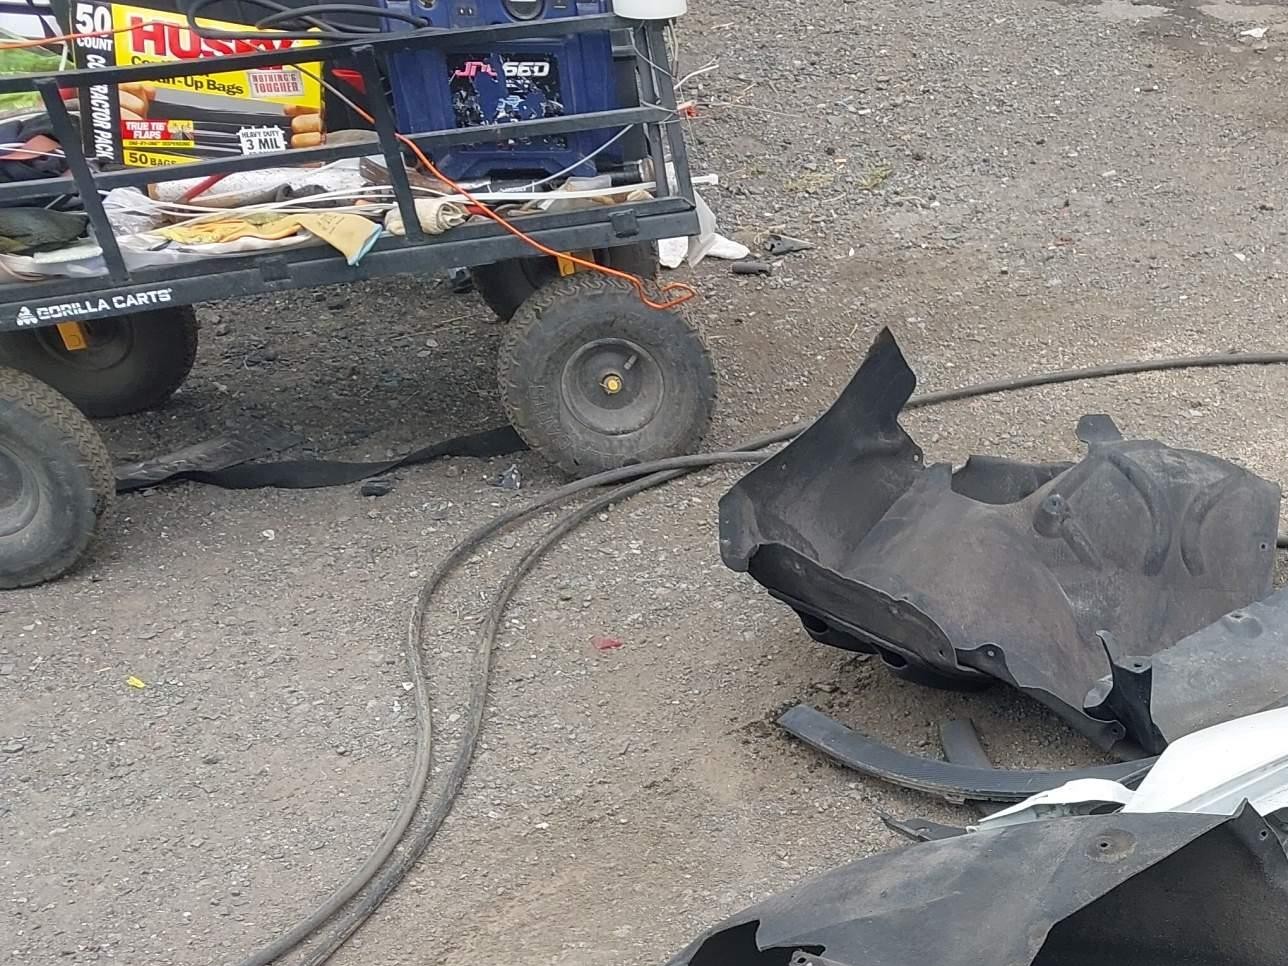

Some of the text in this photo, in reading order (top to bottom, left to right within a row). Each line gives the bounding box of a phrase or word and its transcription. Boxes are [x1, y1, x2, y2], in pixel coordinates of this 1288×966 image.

[75, 3, 112, 38] 50
[77, 37, 113, 51] COUNT
[206, 79, 245, 96] Bags
[253, 82, 299, 93] TOUGHER
[86, 54, 115, 161] CORACTOR PACK
[125, 121, 149, 130] TRUE
[133, 130, 161, 139] FLAPS
[246, 138, 280, 150] 3 MIL
[129, 152, 148, 165] 50
[36, 299, 111, 320] GORILLA
